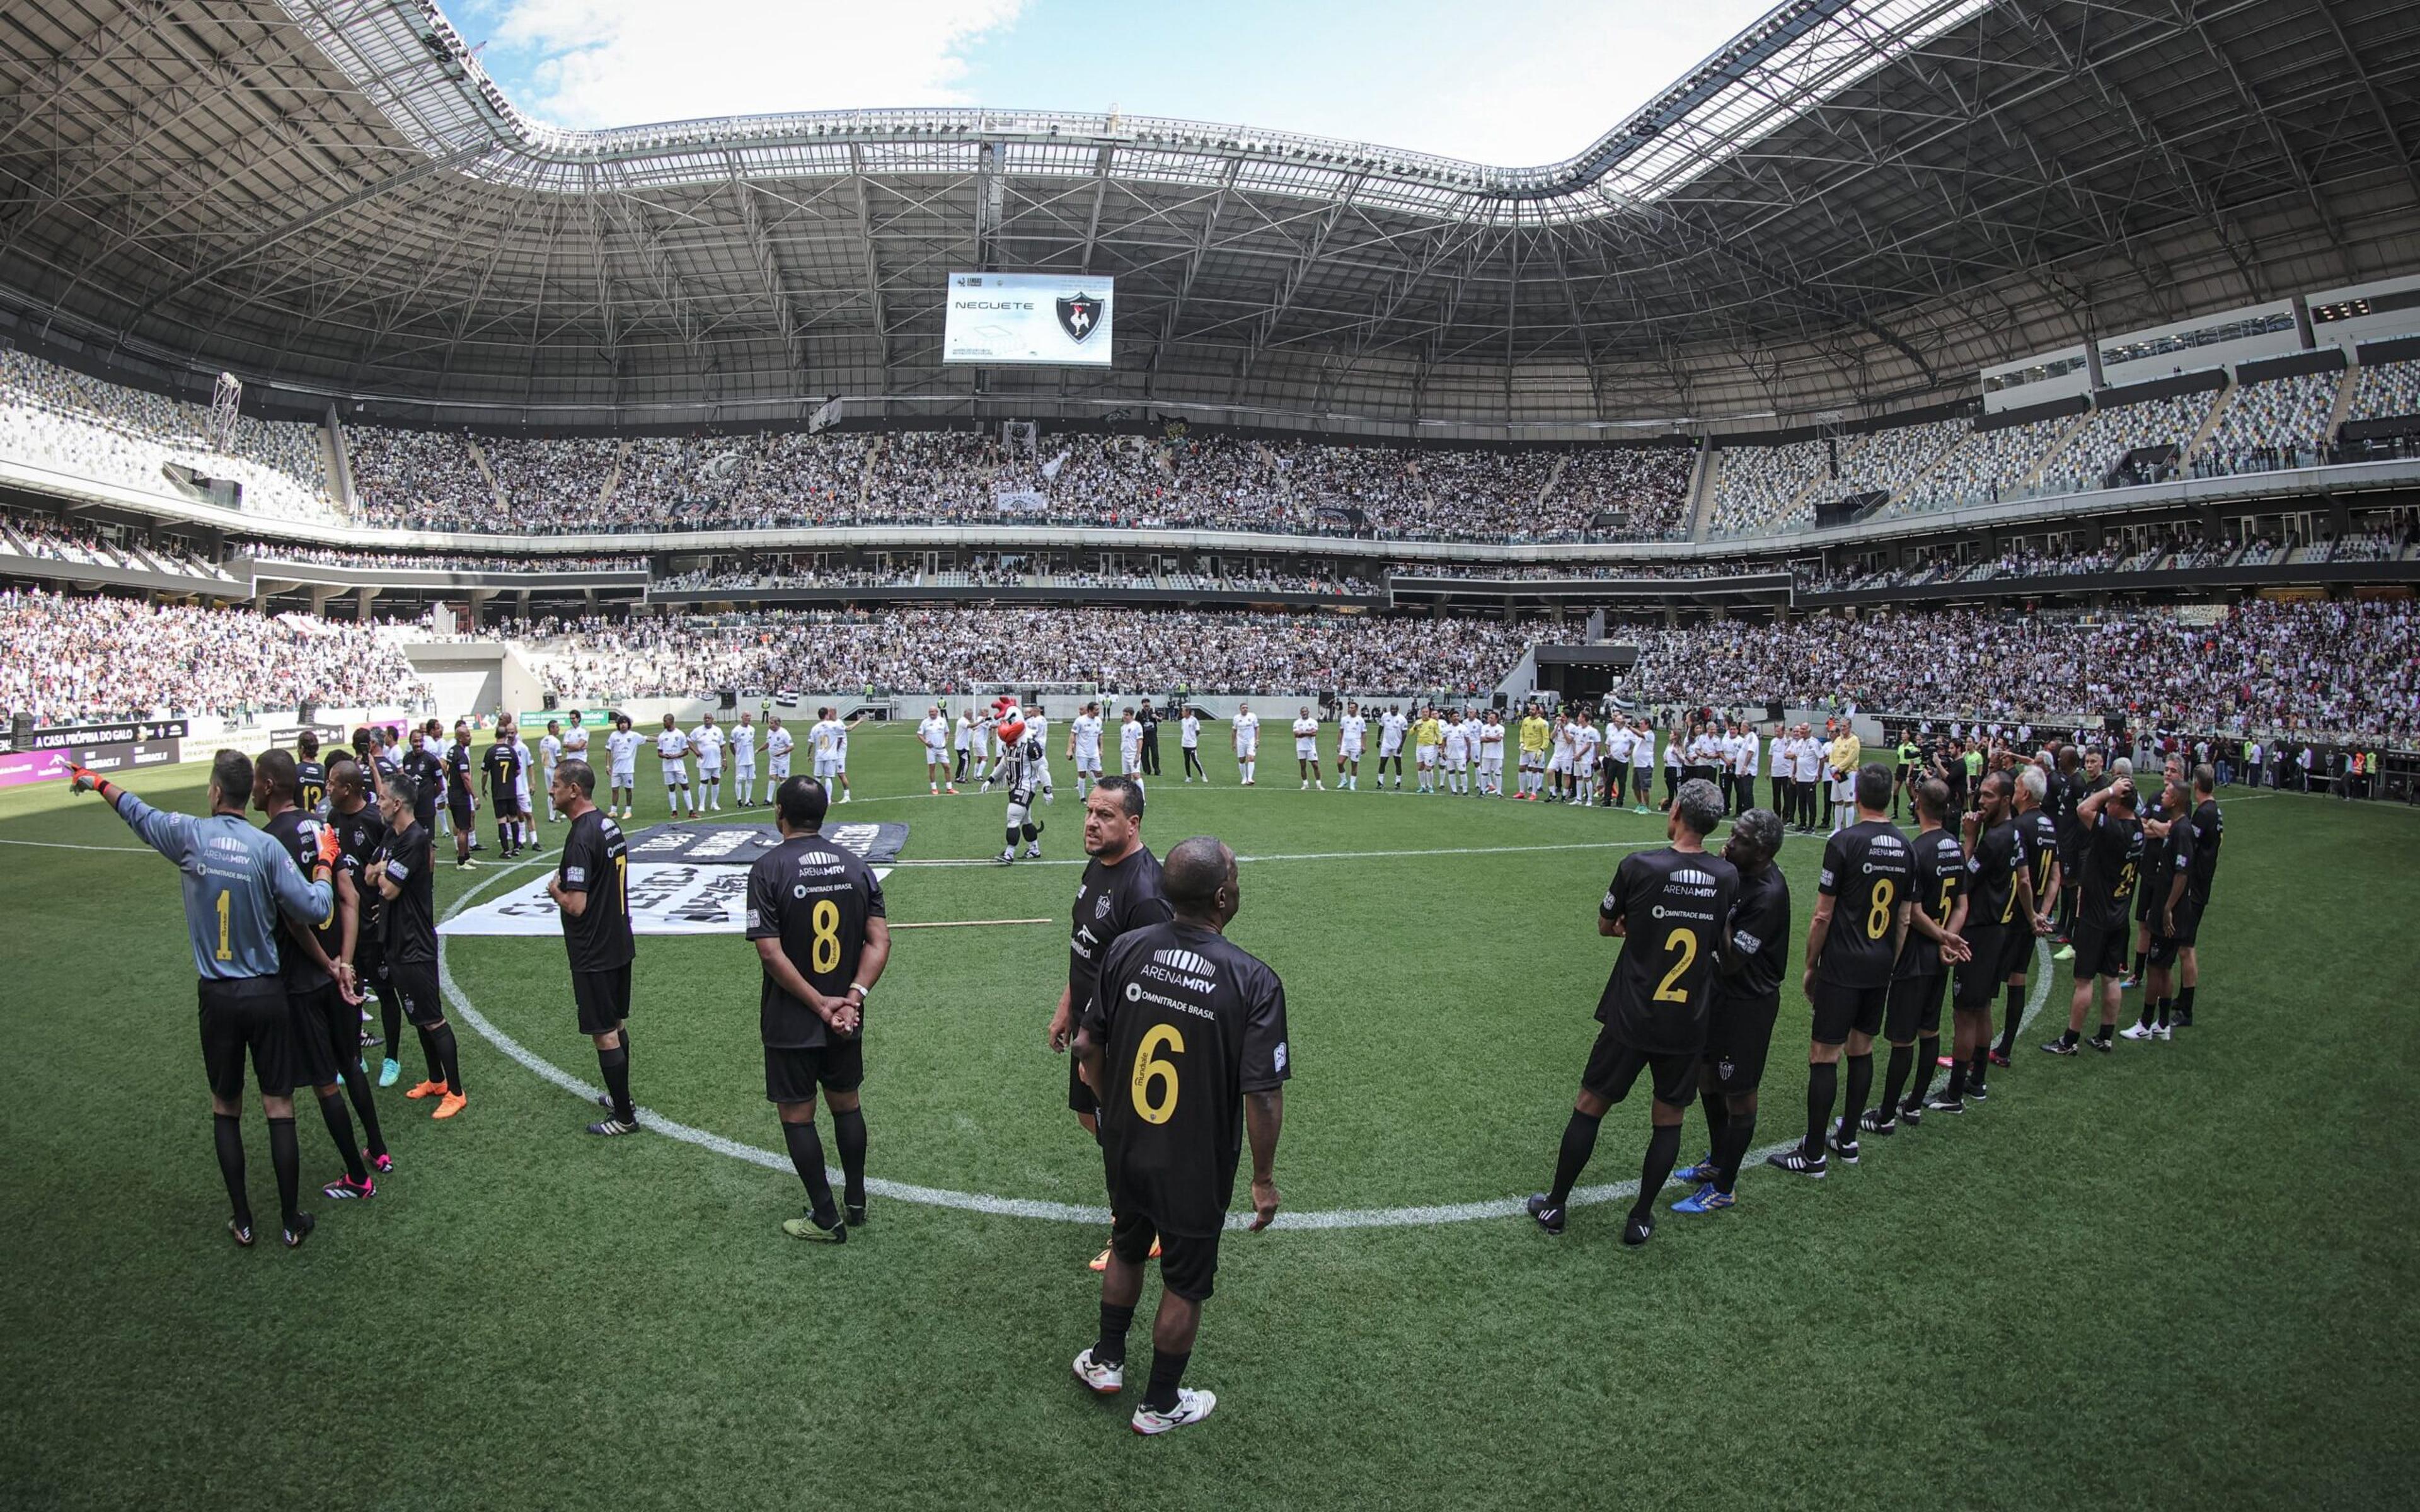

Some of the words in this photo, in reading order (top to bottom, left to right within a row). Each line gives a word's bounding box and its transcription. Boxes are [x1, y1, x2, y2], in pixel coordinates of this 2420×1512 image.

[955, 302, 1034, 310] NEGUETE
[35, 736, 43, 748] A
[43, 735, 65, 747] CASA
[66, 730, 100, 745] PRÓPRIA
[100, 731, 112, 742] DO
[112, 729, 133, 741] GALO
[500, 761, 510, 784] 7
[206, 867, 236, 879] OMNITRADE
[616, 855, 626, 915] 7
[216, 890, 233, 961] 1
[1664, 910, 1698, 919] OMNITRADE
[1868, 878, 1894, 939] 8
[1933, 878, 1956, 929] 5
[813, 900, 841, 974] 8
[1652, 928, 1698, 1003] 2
[1141, 991, 1187, 1012] OMNITRADE
[1187, 1004, 1215, 1021] BRASIL
[1131, 1023, 1185, 1125] 6
